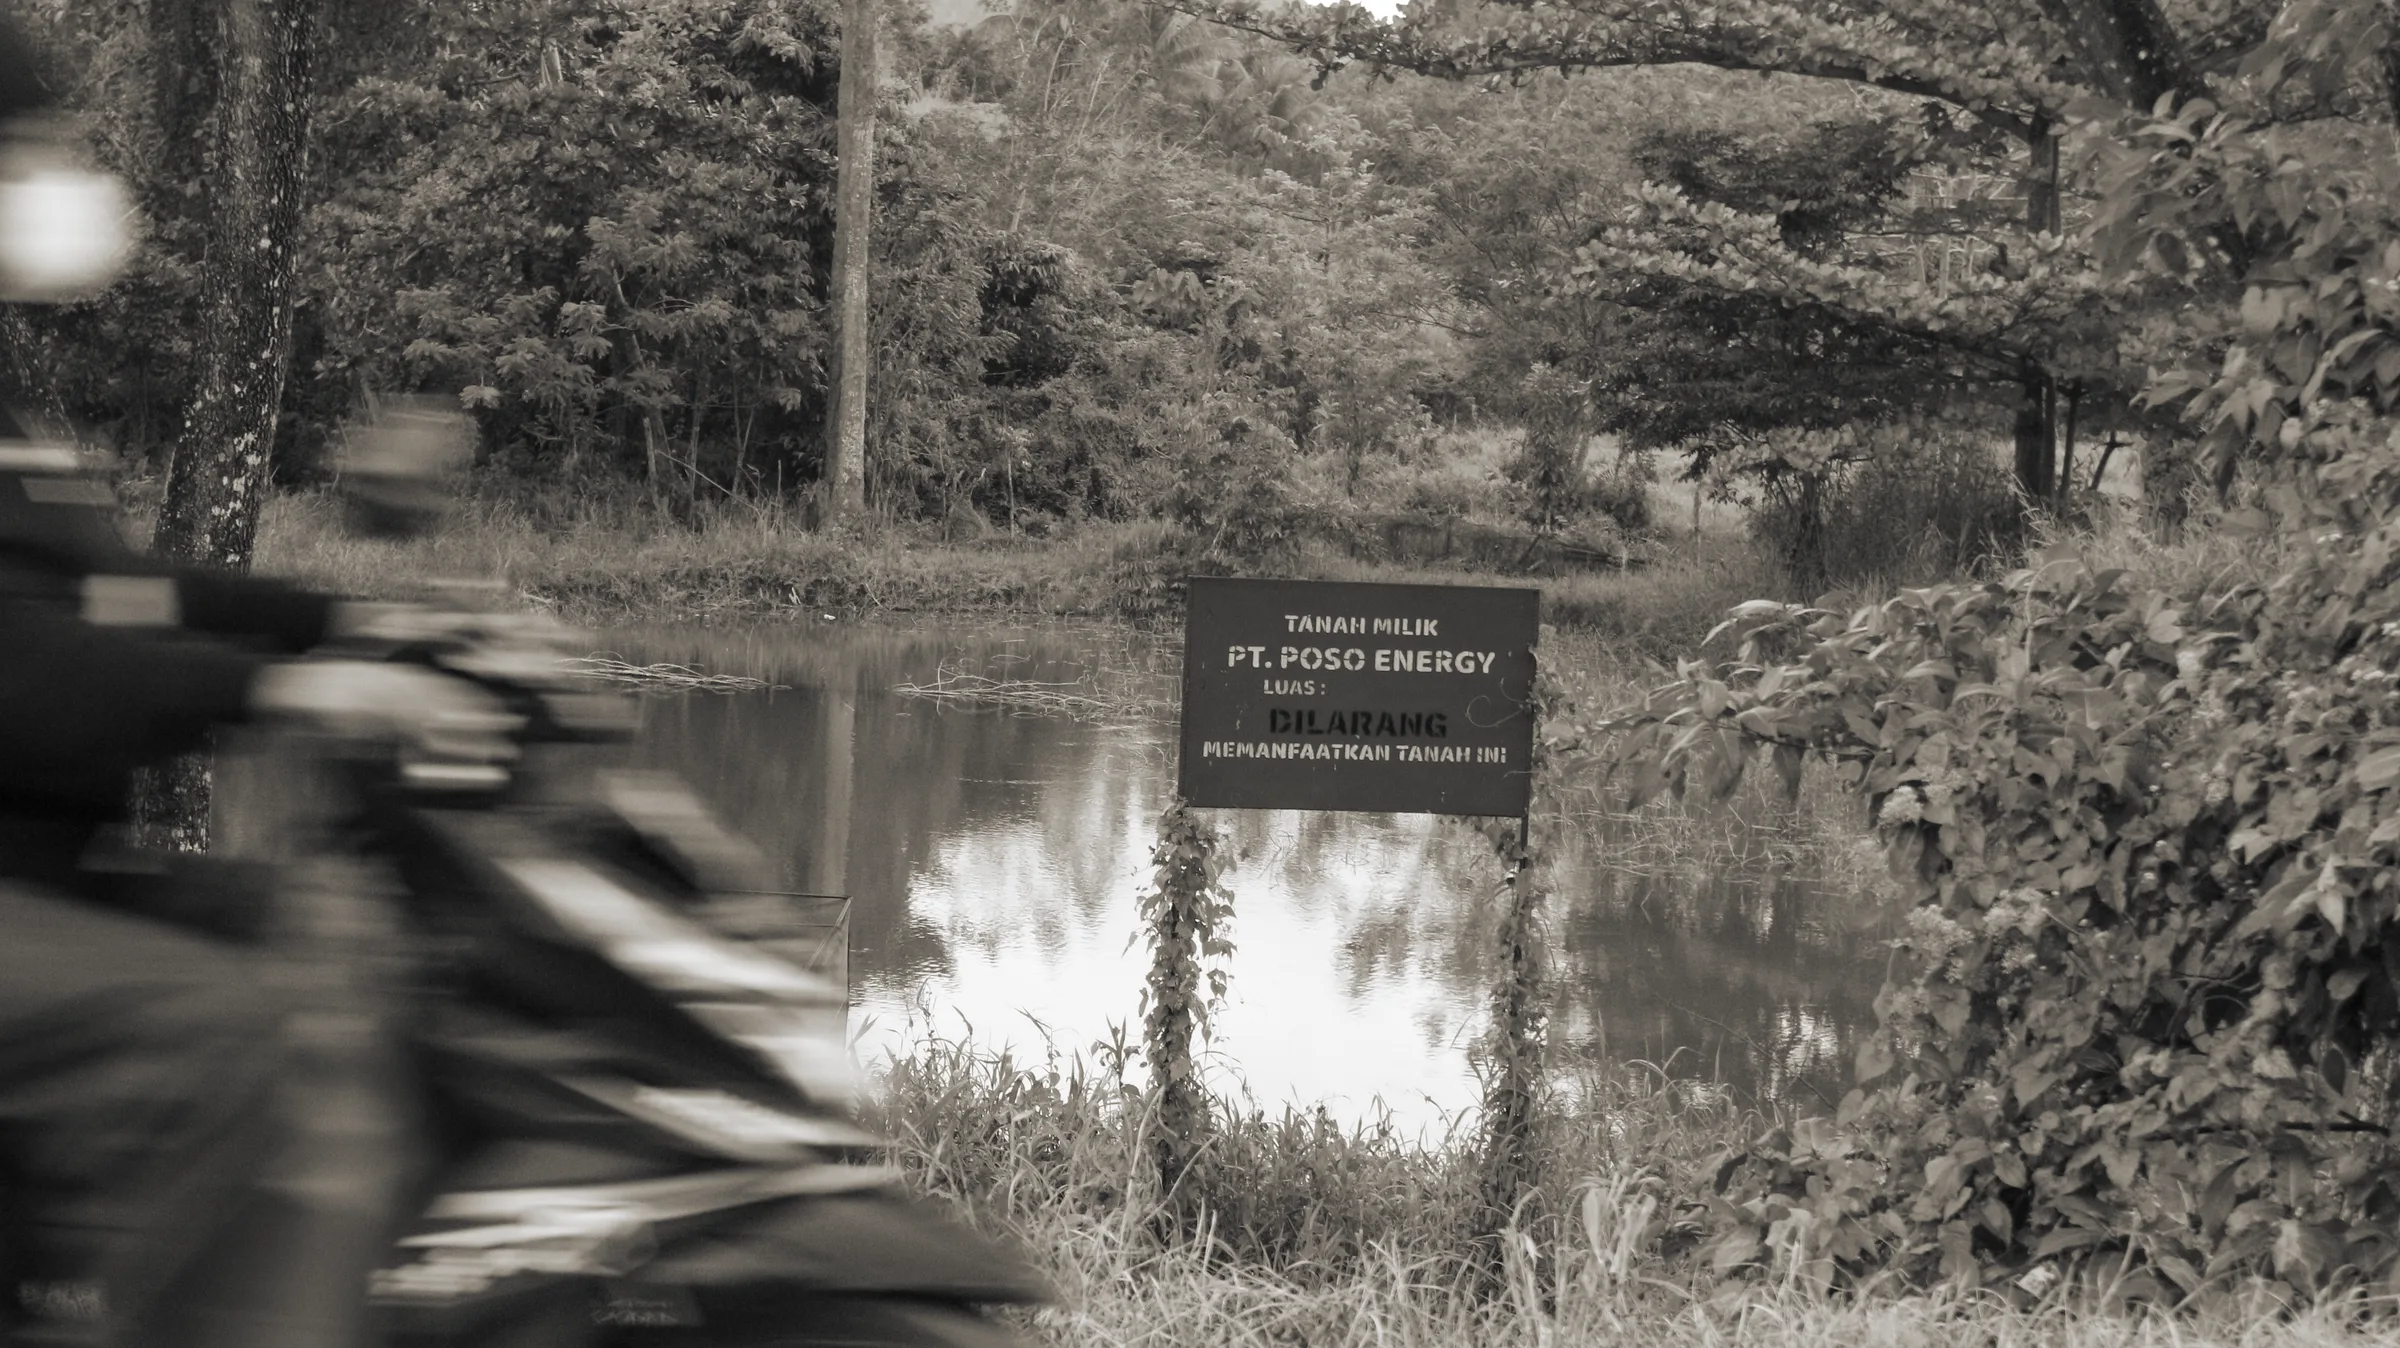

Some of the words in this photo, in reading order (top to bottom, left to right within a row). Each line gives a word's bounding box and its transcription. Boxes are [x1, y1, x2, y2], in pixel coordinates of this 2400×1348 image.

[1284, 614, 1366, 635] TANAH
[1373, 617, 1438, 636] MILIK
[1228, 645, 1272, 669] PT.
[1280, 646, 1365, 671] POSO
[1374, 649, 1496, 674] ENERGY
[1269, 708, 1448, 738] DILARANG
[1203, 741, 1390, 761] MEMANFAATKAN
[1396, 744, 1471, 763] TANAH
[1477, 746, 1507, 763] INI
